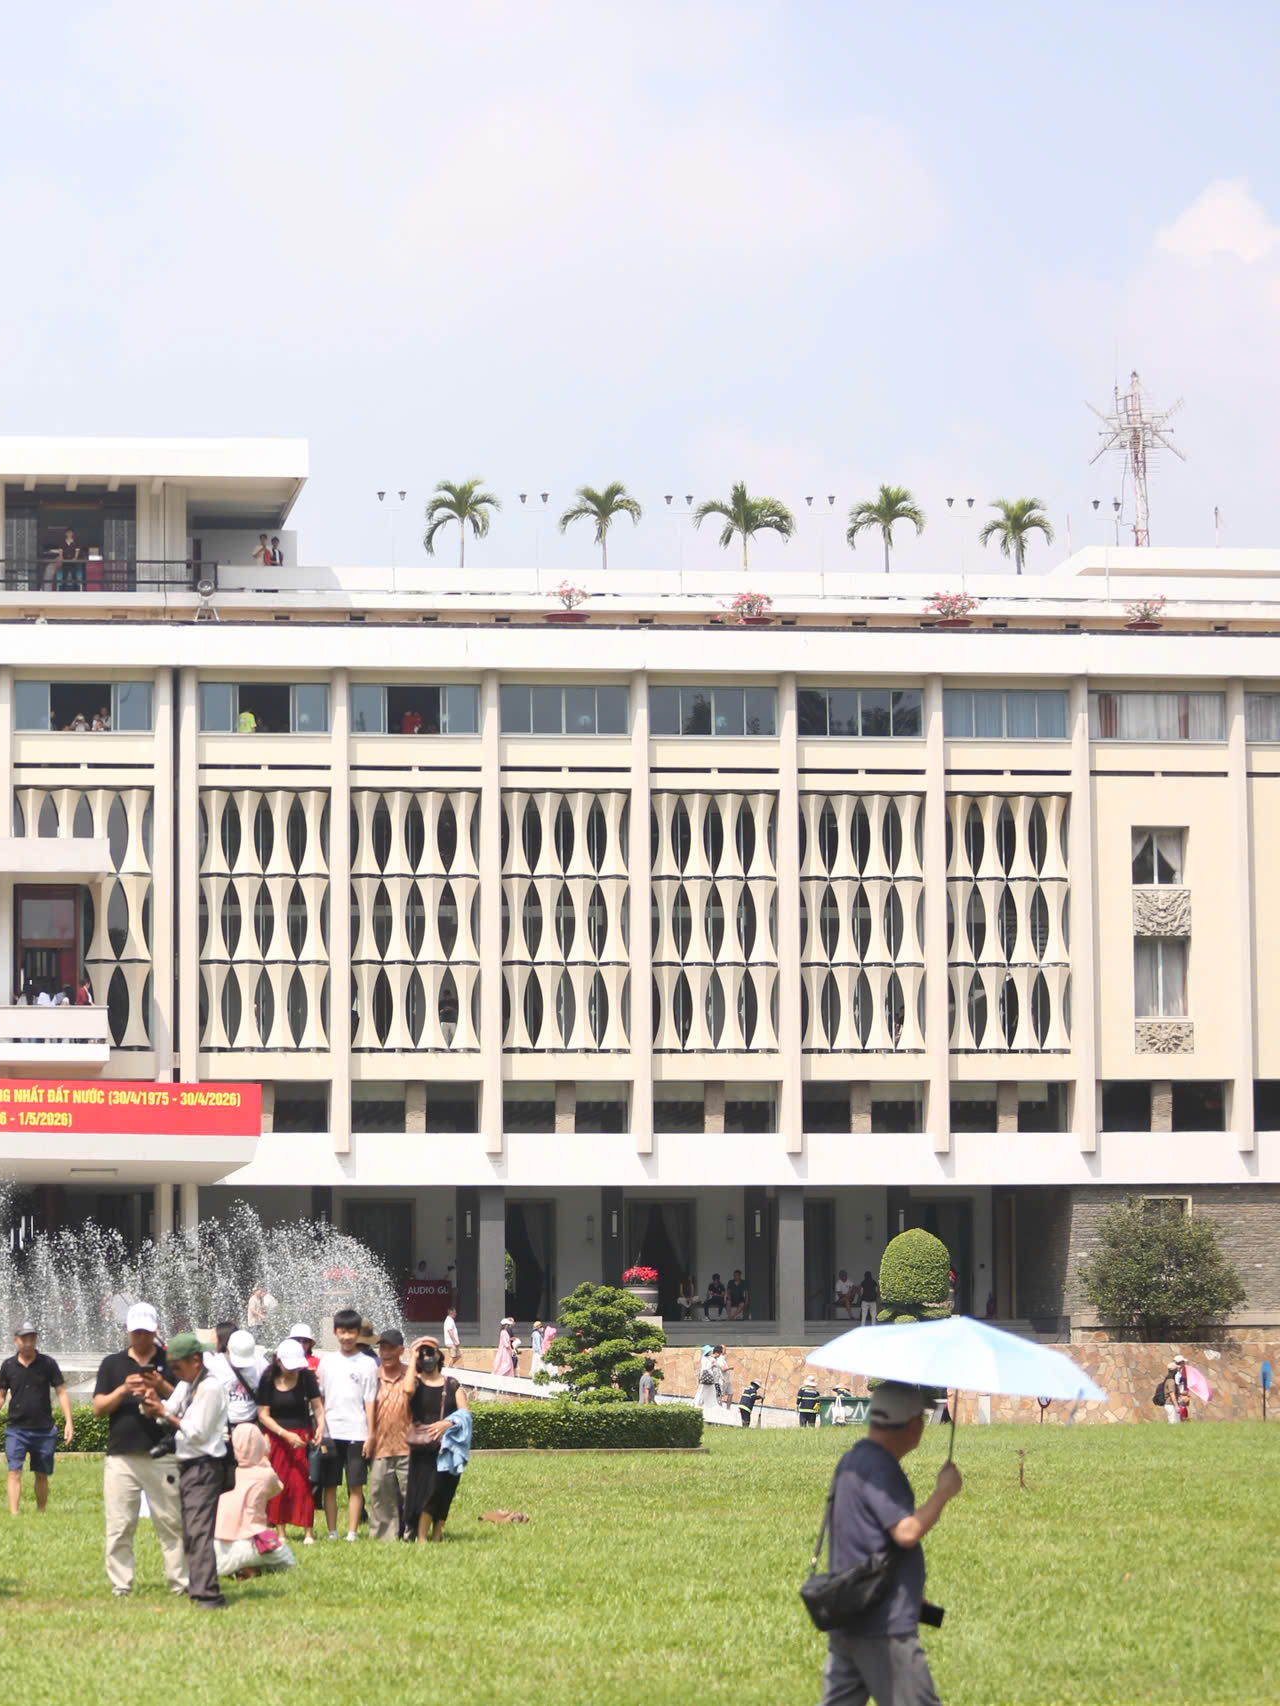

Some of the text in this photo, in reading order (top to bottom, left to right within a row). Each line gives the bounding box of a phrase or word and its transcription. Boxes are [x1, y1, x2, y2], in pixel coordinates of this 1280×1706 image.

[13, 1084, 45, 1103] NHẤT
[47, 1084, 70, 1103] ĐẤT
[72, 1087, 105, 1104] NƯỚC
[108, 1090, 170, 1106] (30/4/1975
[180, 1092, 241, 1107] 30/4/2026)
[18, 1112, 73, 1127] 1/5/2026)
[407, 1286, 435, 1295] AUDIO
